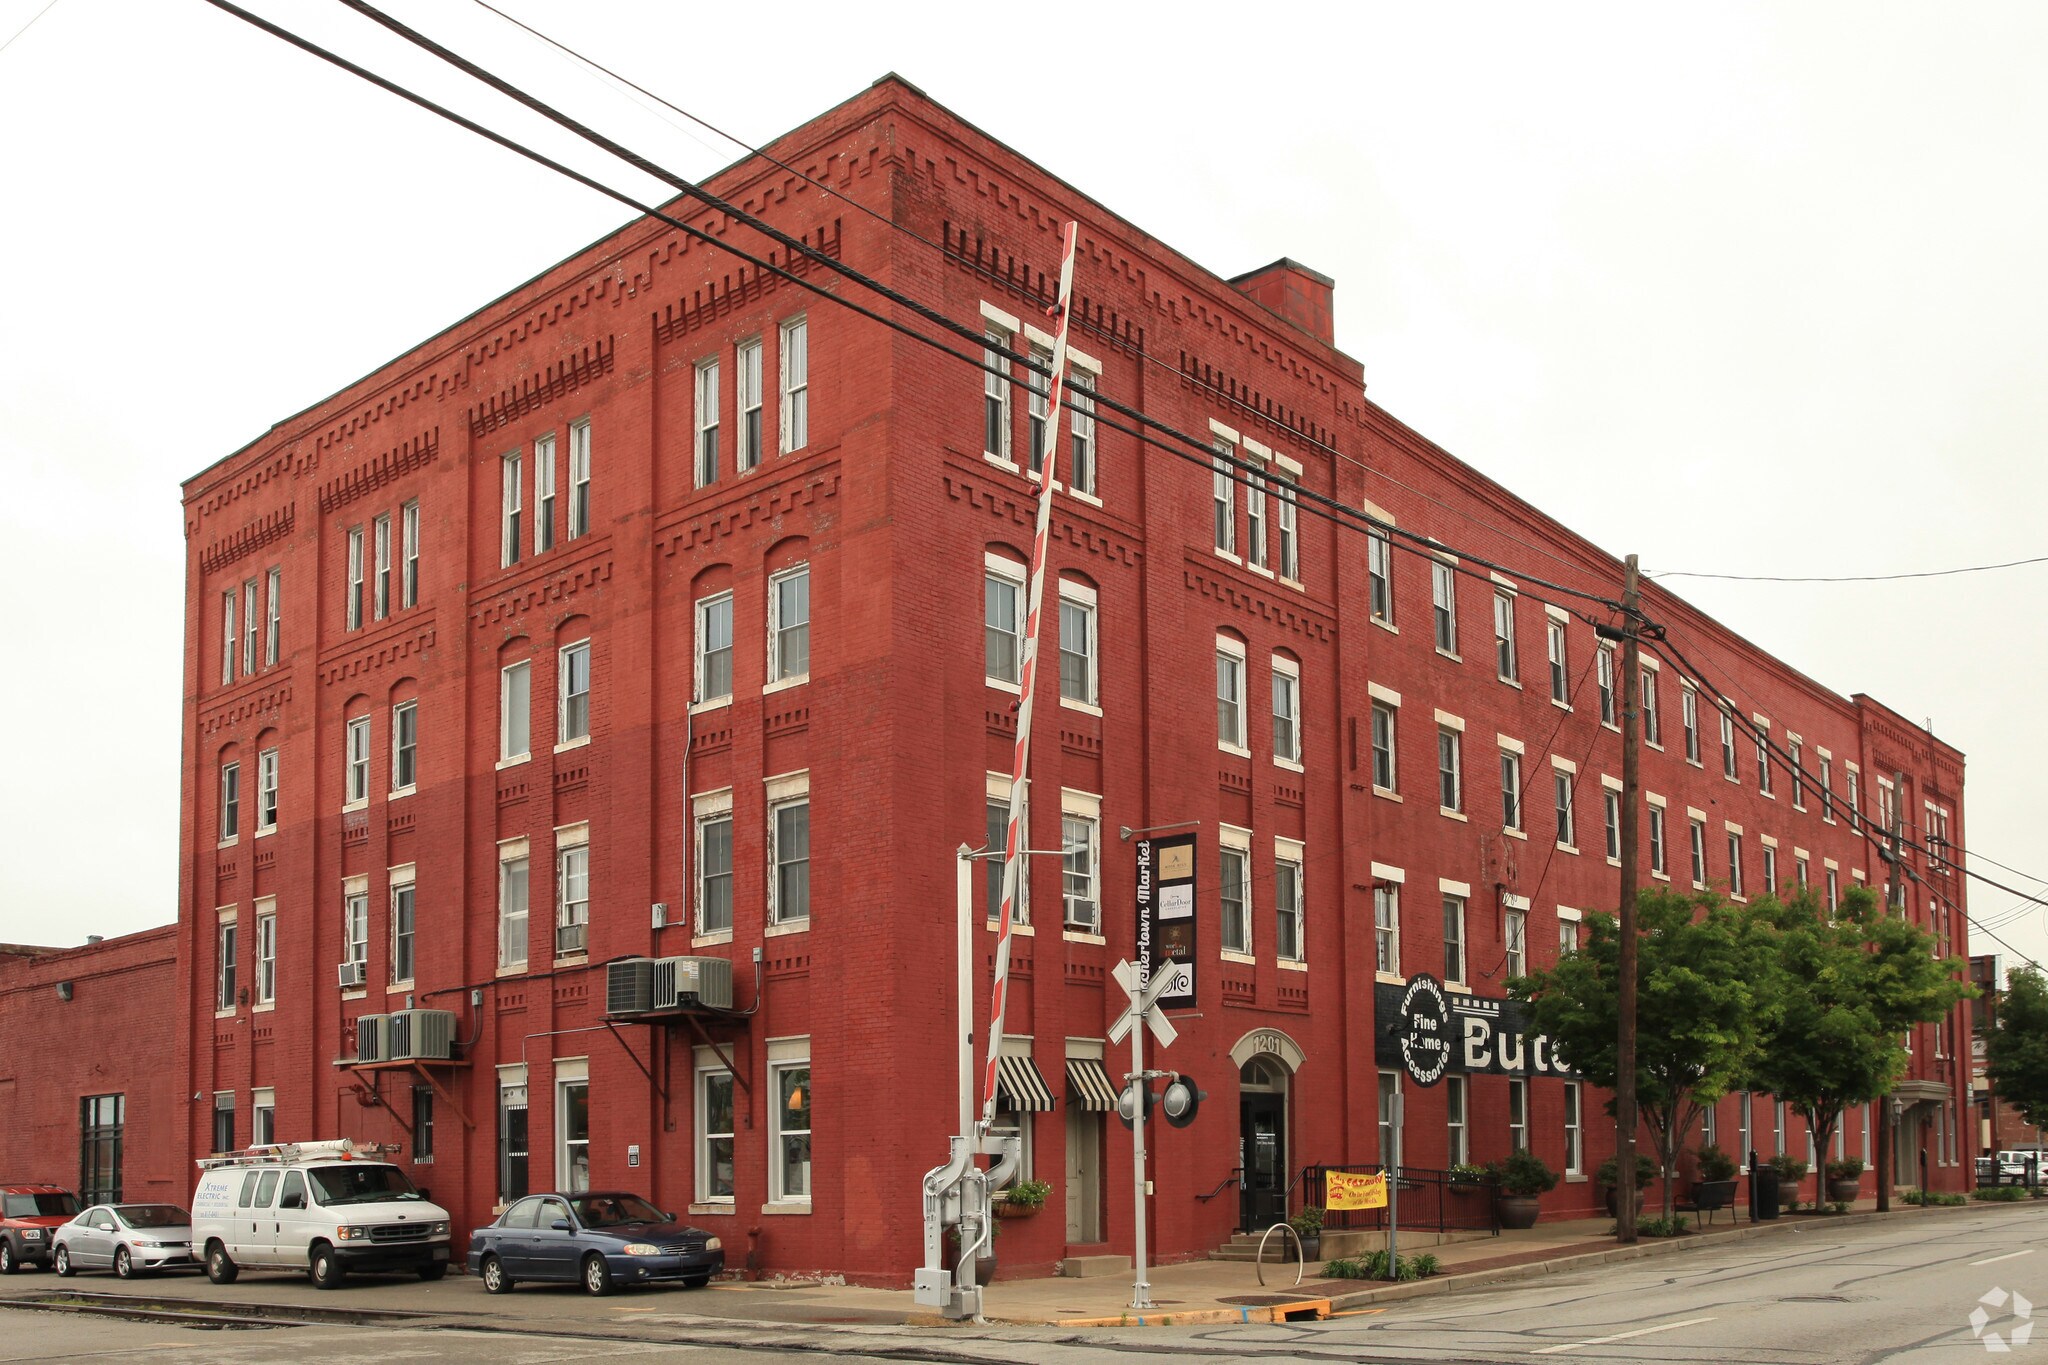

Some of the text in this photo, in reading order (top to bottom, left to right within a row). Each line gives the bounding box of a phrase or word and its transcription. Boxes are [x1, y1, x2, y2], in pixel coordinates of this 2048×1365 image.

[1137, 840, 1150, 904] Market
[1401, 977, 1449, 1023] Furnishings
[1413, 1013, 1437, 1030] Fine
[1254, 1035, 1282, 1056] 1201
[1401, 1037, 1450, 1082] Accessories
[205, 1182, 229, 1191] XTREME
